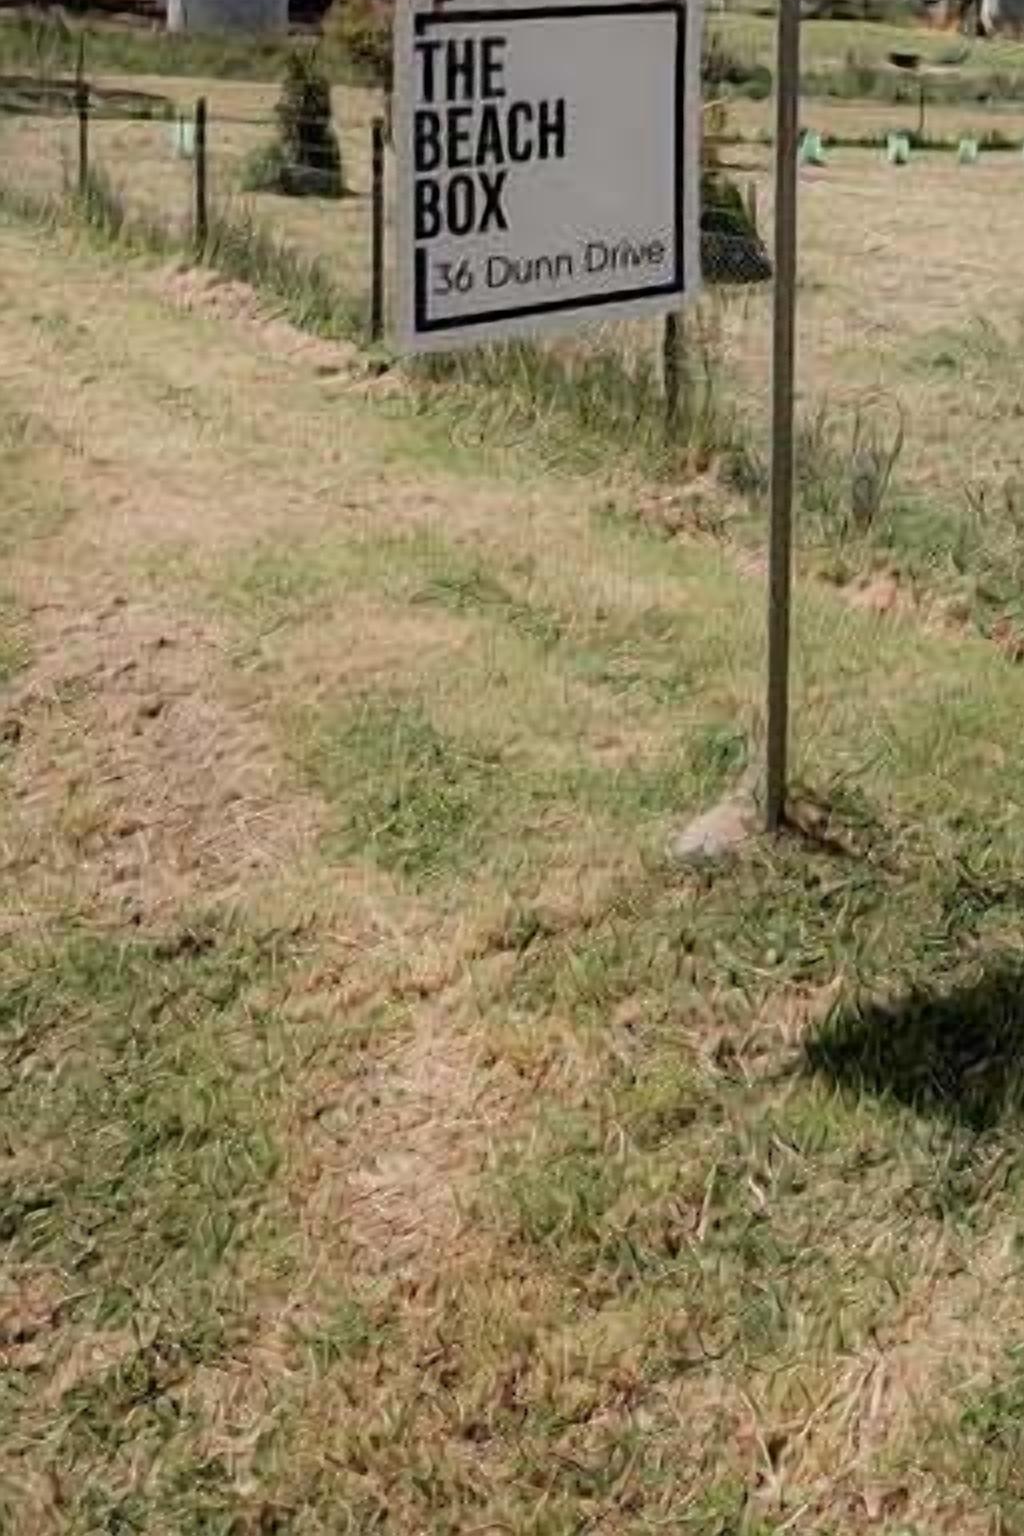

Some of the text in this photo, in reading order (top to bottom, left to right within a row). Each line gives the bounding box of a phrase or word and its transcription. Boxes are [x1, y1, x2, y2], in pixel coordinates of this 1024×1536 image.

[415, 36, 507, 103] THE
[415, 98, 566, 172] BEACH
[415, 169, 508, 241] BOX
[432, 239, 666, 295] 36 Dunn Drive
